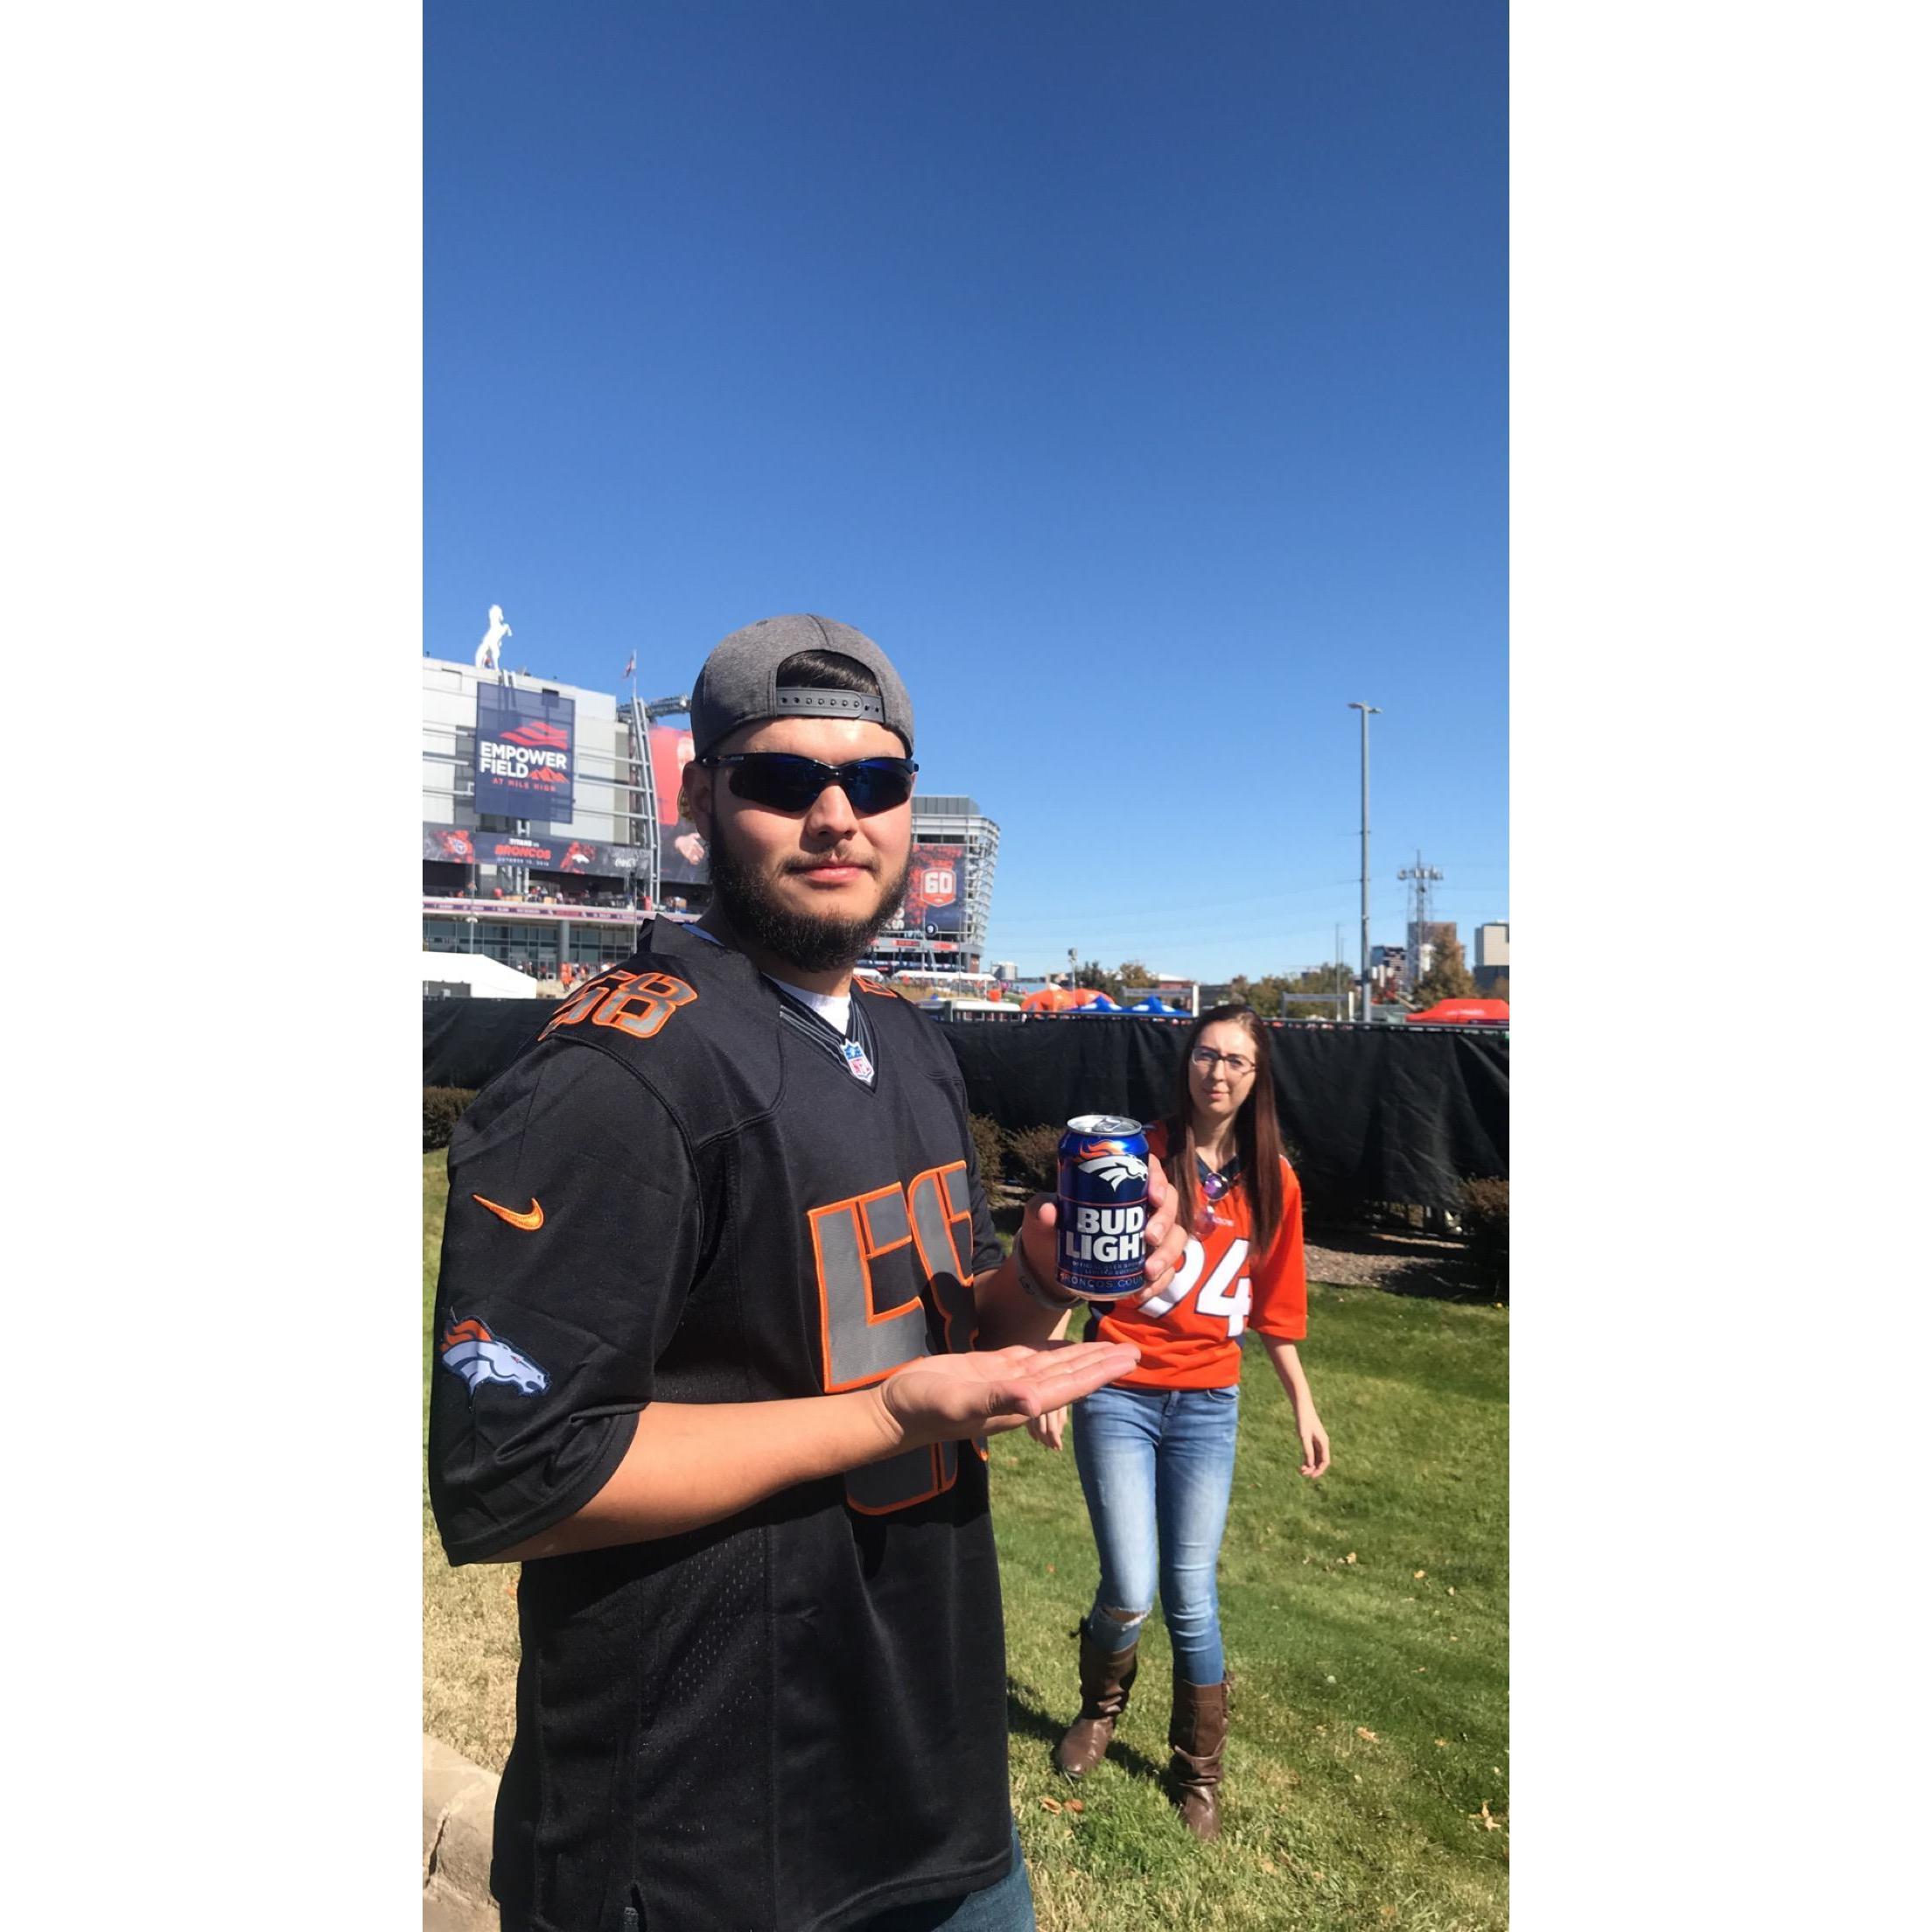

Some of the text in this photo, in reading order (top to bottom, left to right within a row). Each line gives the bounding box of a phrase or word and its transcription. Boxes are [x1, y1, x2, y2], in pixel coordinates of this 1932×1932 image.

[480, 741, 567, 769] EMPOWER
[480, 758, 529, 779] FIELD
[508, 780, 529, 789] MILE
[495, 845, 551, 859] BRONCOS
[924, 872, 954, 894] 60
[1077, 1206, 1144, 1236] BUD
